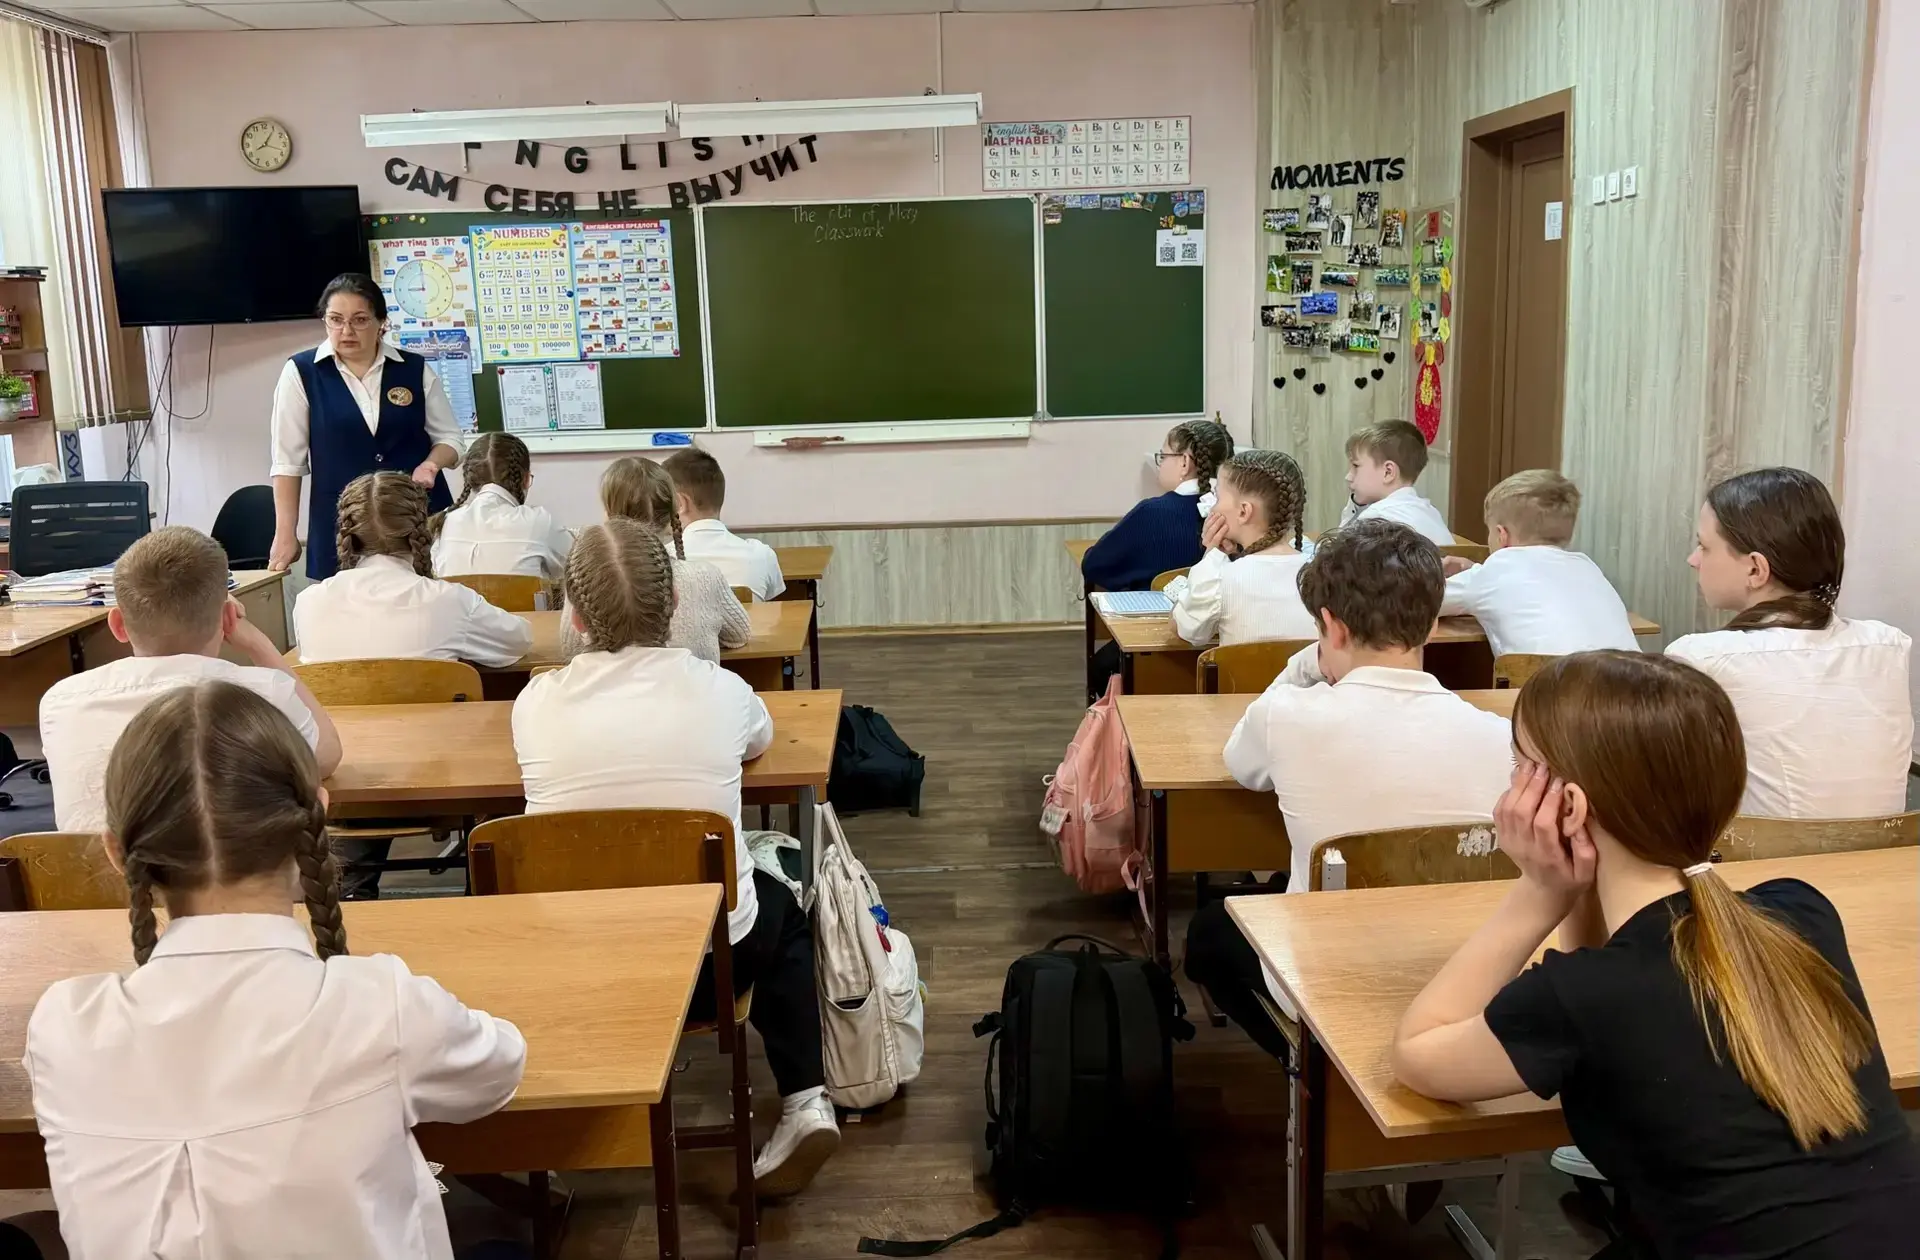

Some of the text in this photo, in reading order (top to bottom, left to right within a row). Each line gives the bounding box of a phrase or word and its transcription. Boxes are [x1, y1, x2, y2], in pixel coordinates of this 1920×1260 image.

[992, 136, 1055, 146] ALPHABET
[385, 135, 817, 219] САМ СЕБЯ НЕ ВЫУЧИТ
[1271, 157, 1406, 190] MOMENTS
[792, 205, 816, 224] The
[863, 204, 880, 222] of
[494, 228, 550, 239] NUMBERS
[814, 220, 884, 243] Classwork
[496, 252, 502, 260] 2
[533, 251, 538, 259] 4
[552, 251, 557, 259] 5
[479, 271, 485, 279] 6
[497, 270, 503, 278] 7
[516, 270, 522, 278] 8
[534, 269, 540, 277] 9
[537, 286, 547, 294] 14
[540, 304, 550, 312] 19
